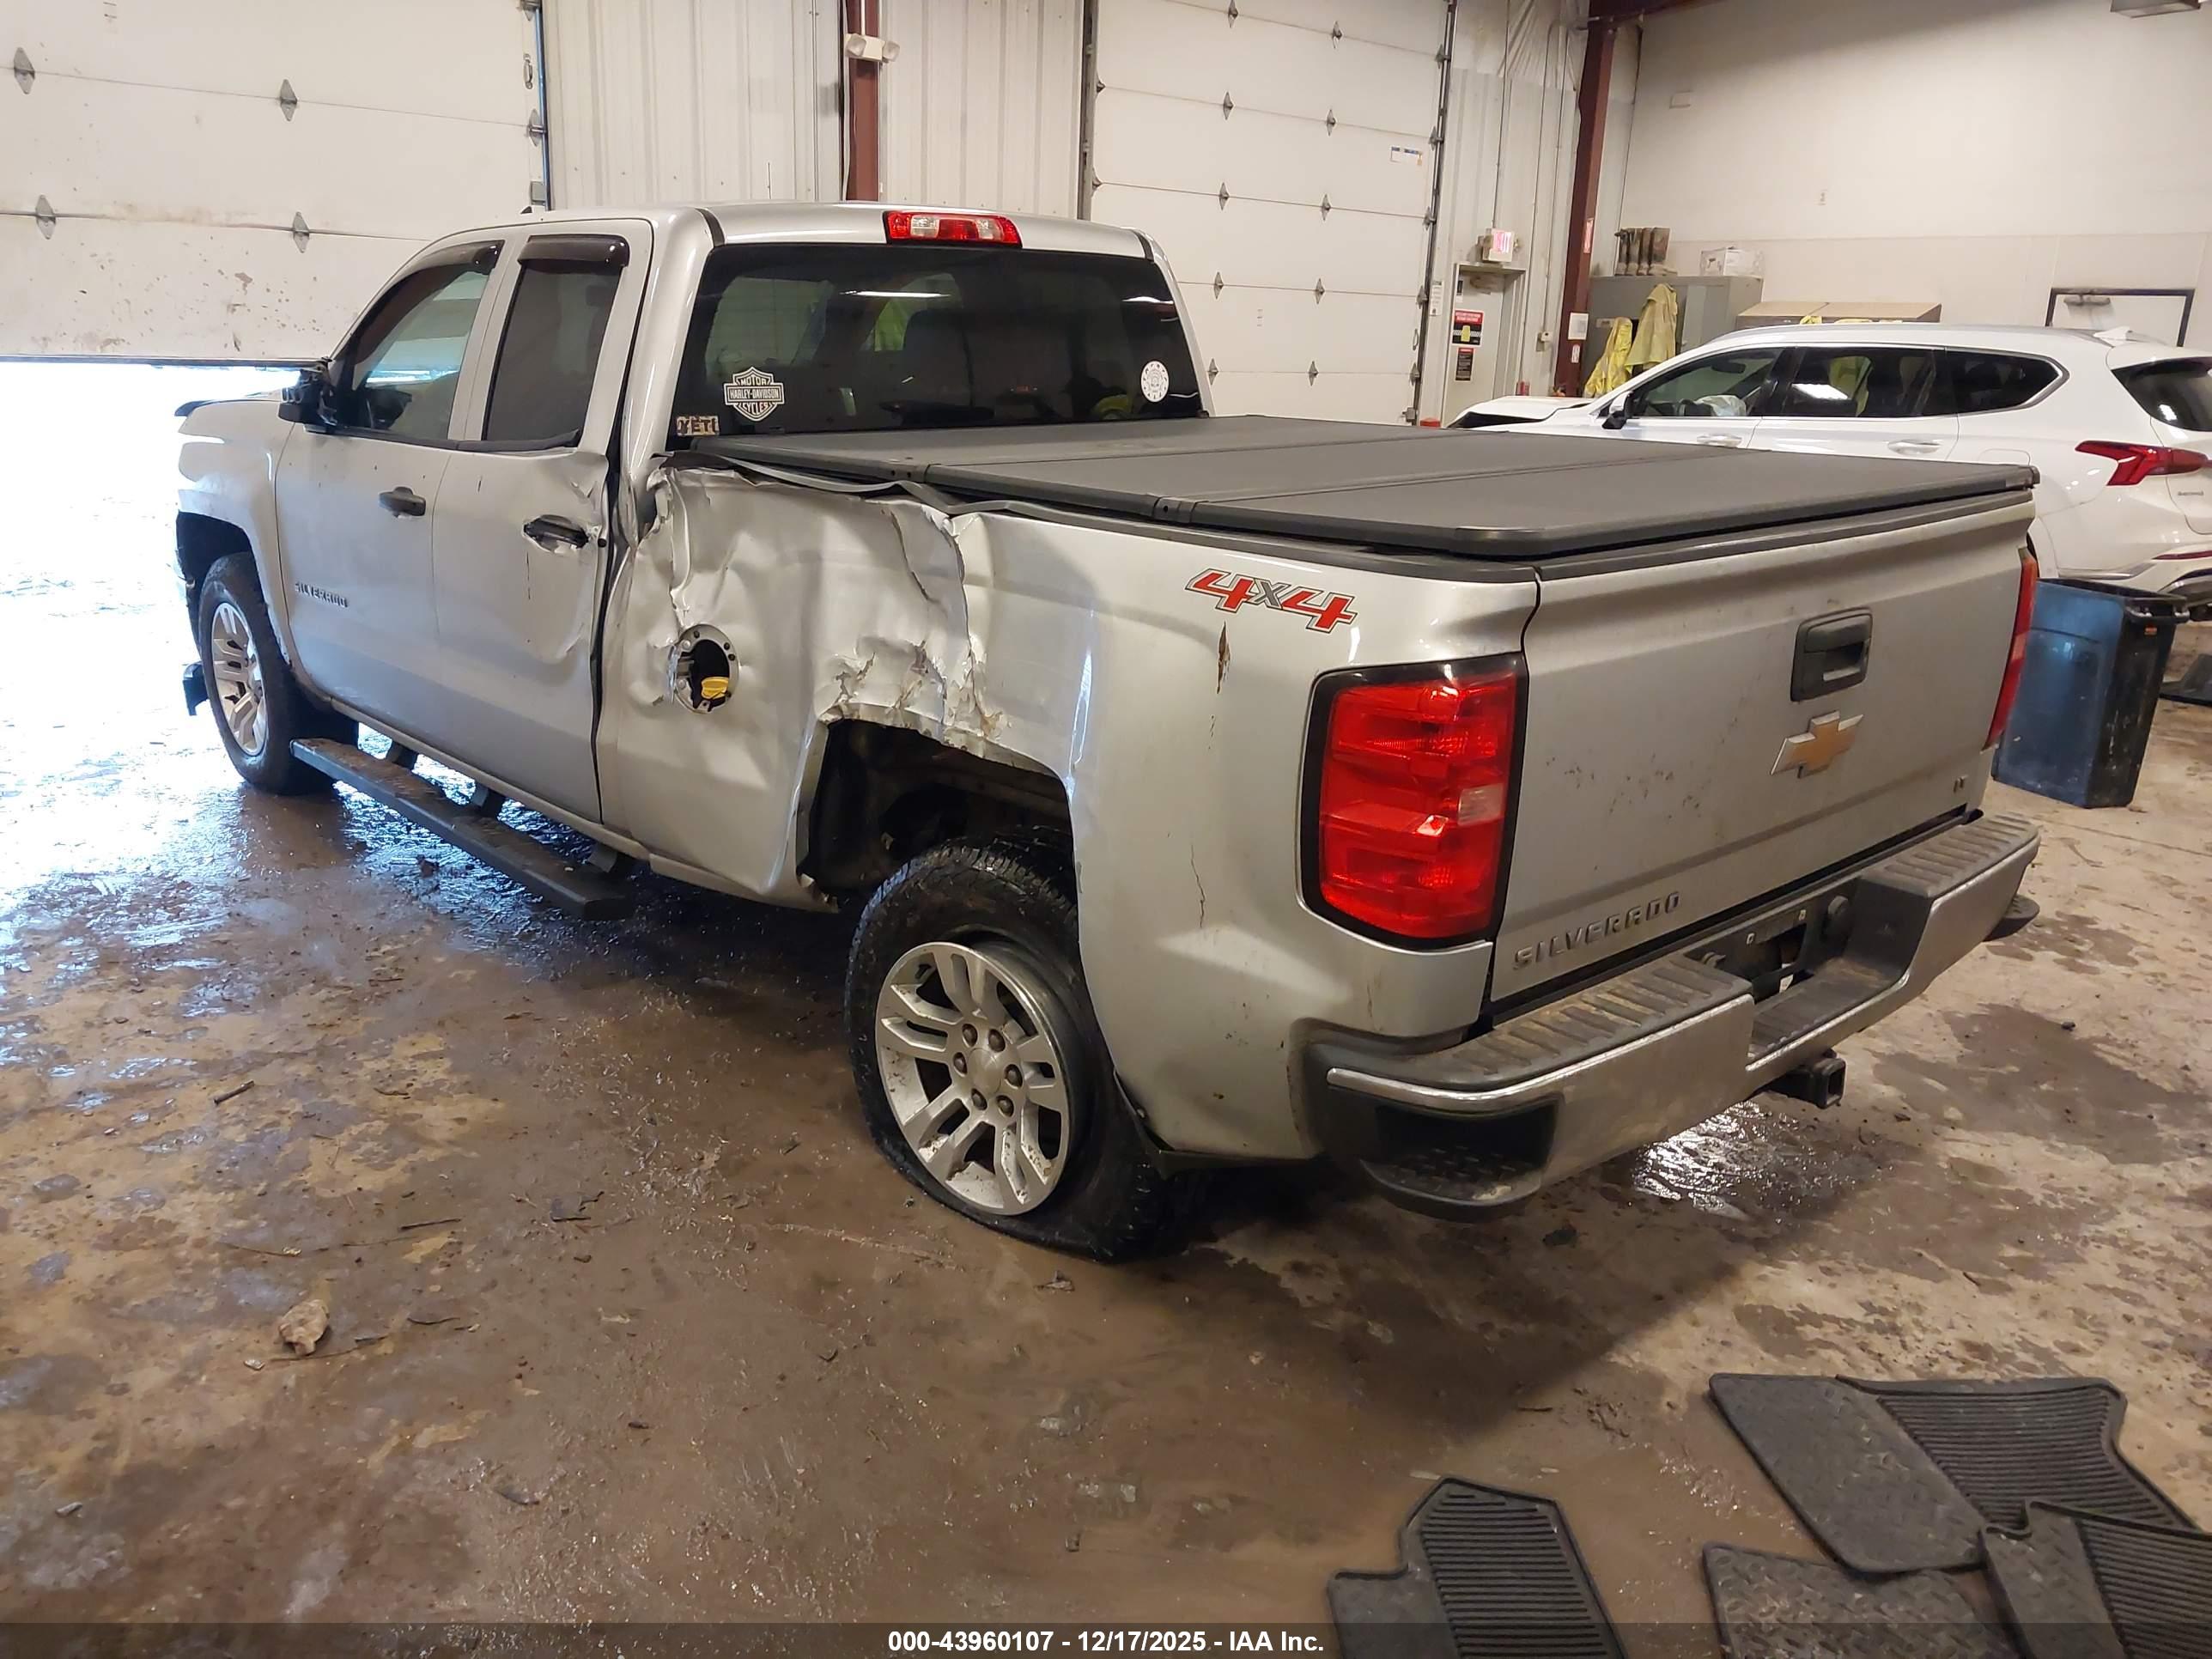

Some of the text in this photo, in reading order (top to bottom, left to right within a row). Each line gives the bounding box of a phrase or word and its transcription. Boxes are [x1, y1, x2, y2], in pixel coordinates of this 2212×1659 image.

[740, 374, 767, 386] MOTOR
[730, 388, 779, 399] HARLEY-DAVIDSON
[678, 418, 717, 434] YETI
[1513, 890, 1681, 969] SILVERADO
